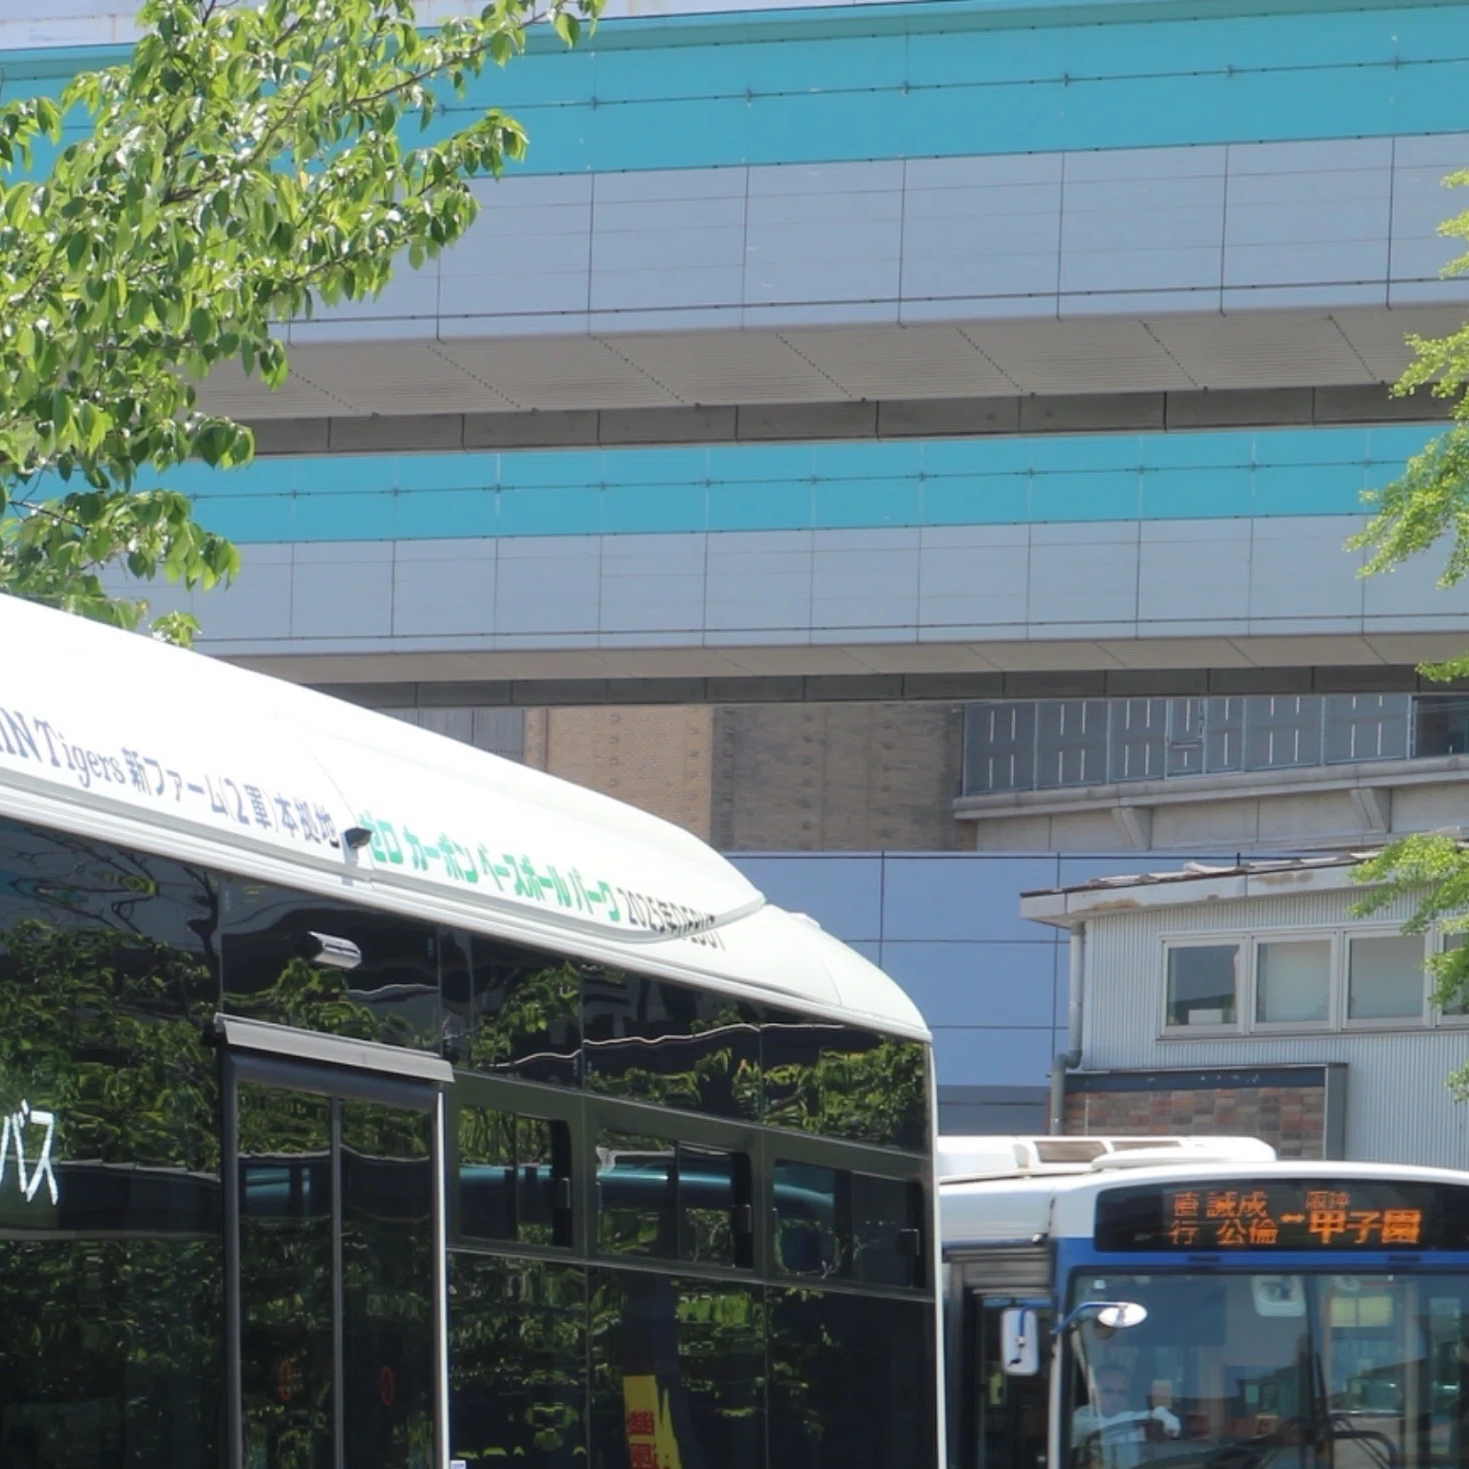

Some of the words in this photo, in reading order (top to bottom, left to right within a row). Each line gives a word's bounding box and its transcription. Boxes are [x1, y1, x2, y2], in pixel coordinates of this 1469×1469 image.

[33, 716, 126, 789] Tigers
[1309, 1208, 1422, 1244] 甲子園
